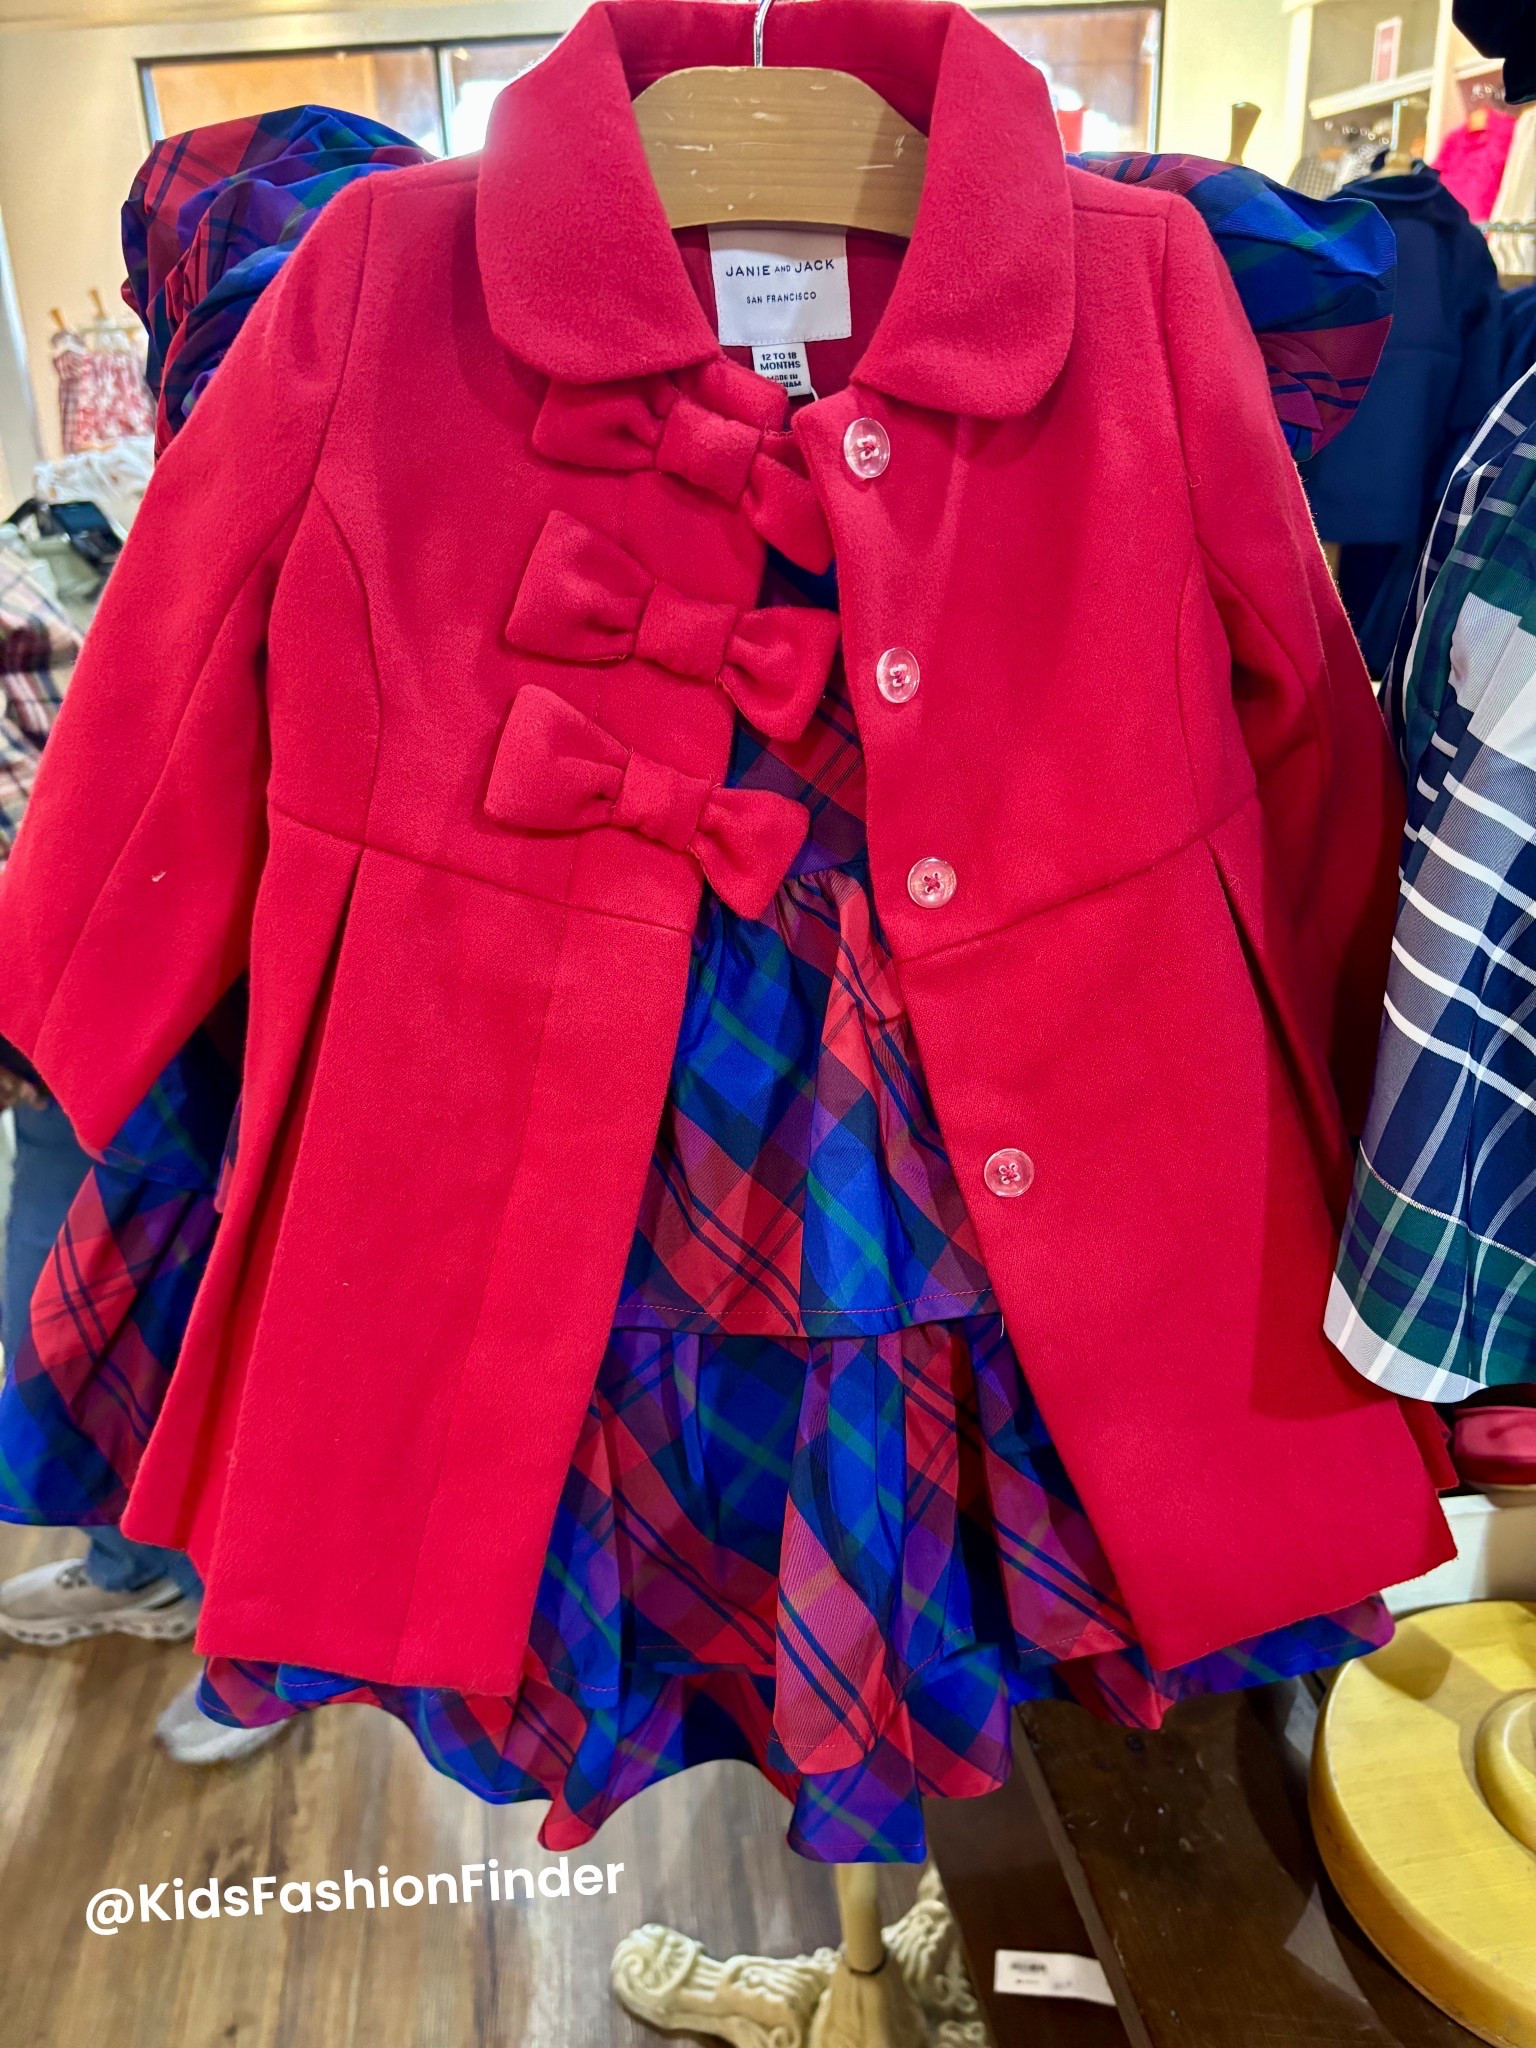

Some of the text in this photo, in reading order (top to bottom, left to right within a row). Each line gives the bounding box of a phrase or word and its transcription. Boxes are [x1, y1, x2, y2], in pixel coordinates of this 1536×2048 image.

[725, 258, 835, 277] JANIE AND JACK
[746, 291, 817, 304] SAN FRANCISCO
[787, 352, 797, 360] 18
[760, 361, 801, 371] MONTHS
